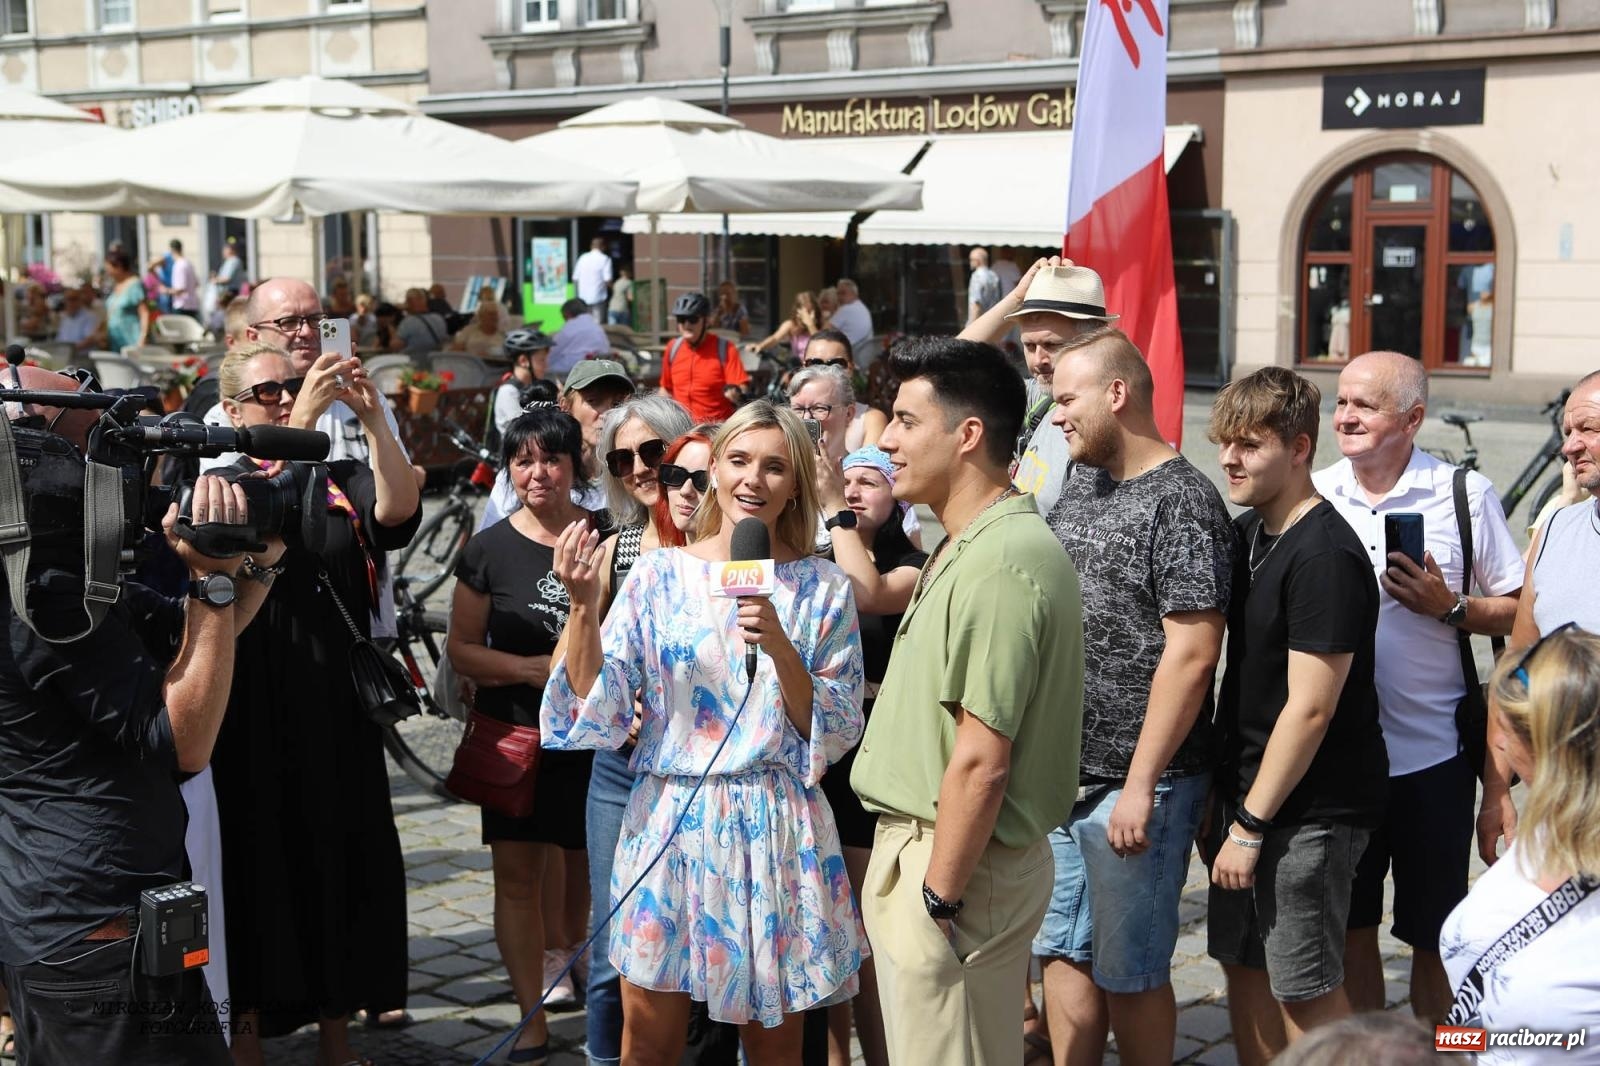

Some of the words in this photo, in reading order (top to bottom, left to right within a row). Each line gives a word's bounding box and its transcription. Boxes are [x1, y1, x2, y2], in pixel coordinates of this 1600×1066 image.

[1377, 89, 1461, 109] HORAJ
[781, 97, 925, 135] Manufaktura
[933, 93, 1020, 132] Lodów
[1027, 87, 1077, 128] Gał
[1094, 529, 1137, 548] HILFIGER
